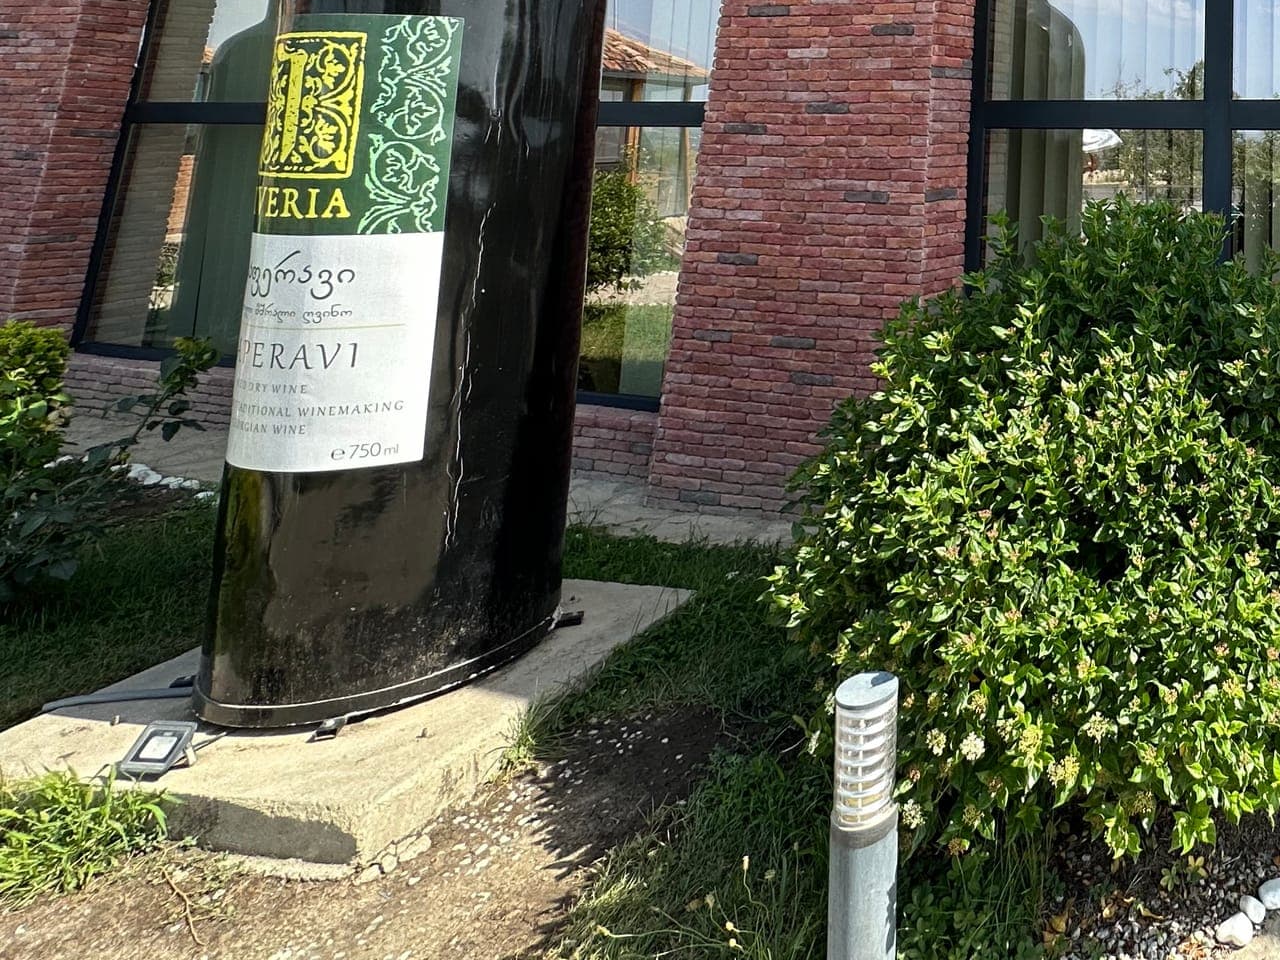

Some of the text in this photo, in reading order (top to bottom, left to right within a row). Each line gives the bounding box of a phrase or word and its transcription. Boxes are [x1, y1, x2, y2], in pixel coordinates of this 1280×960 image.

[255, 186, 350, 218] VERIA
[249, 250, 356, 300] ფერავი
[239, 339, 358, 370] PERAVI
[272, 384, 307, 394] WINE
[240, 400, 404, 418] ADITIONAL WINEMAKING
[272, 424, 306, 435] WINE
